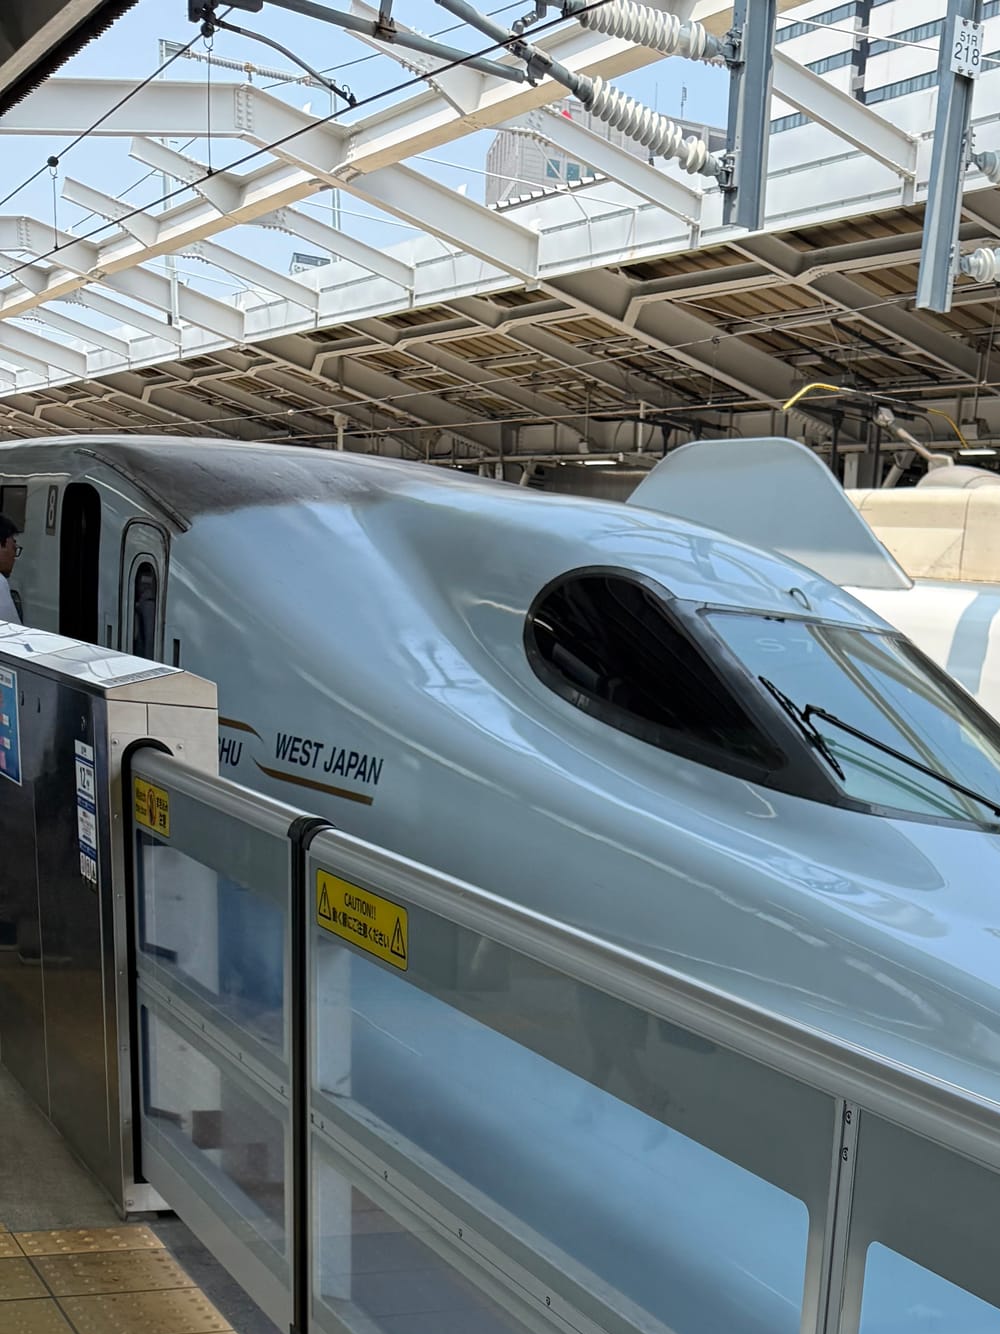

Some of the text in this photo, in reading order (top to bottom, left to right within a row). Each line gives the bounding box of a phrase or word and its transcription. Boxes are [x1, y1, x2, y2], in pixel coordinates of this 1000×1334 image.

[960, 31, 978, 46] 51R
[954, 42, 980, 66] 218
[48, 489, 56, 527] 8
[275, 732, 384, 785] WEST JAPAN
[344, 892, 376, 920] CAUTION!!
